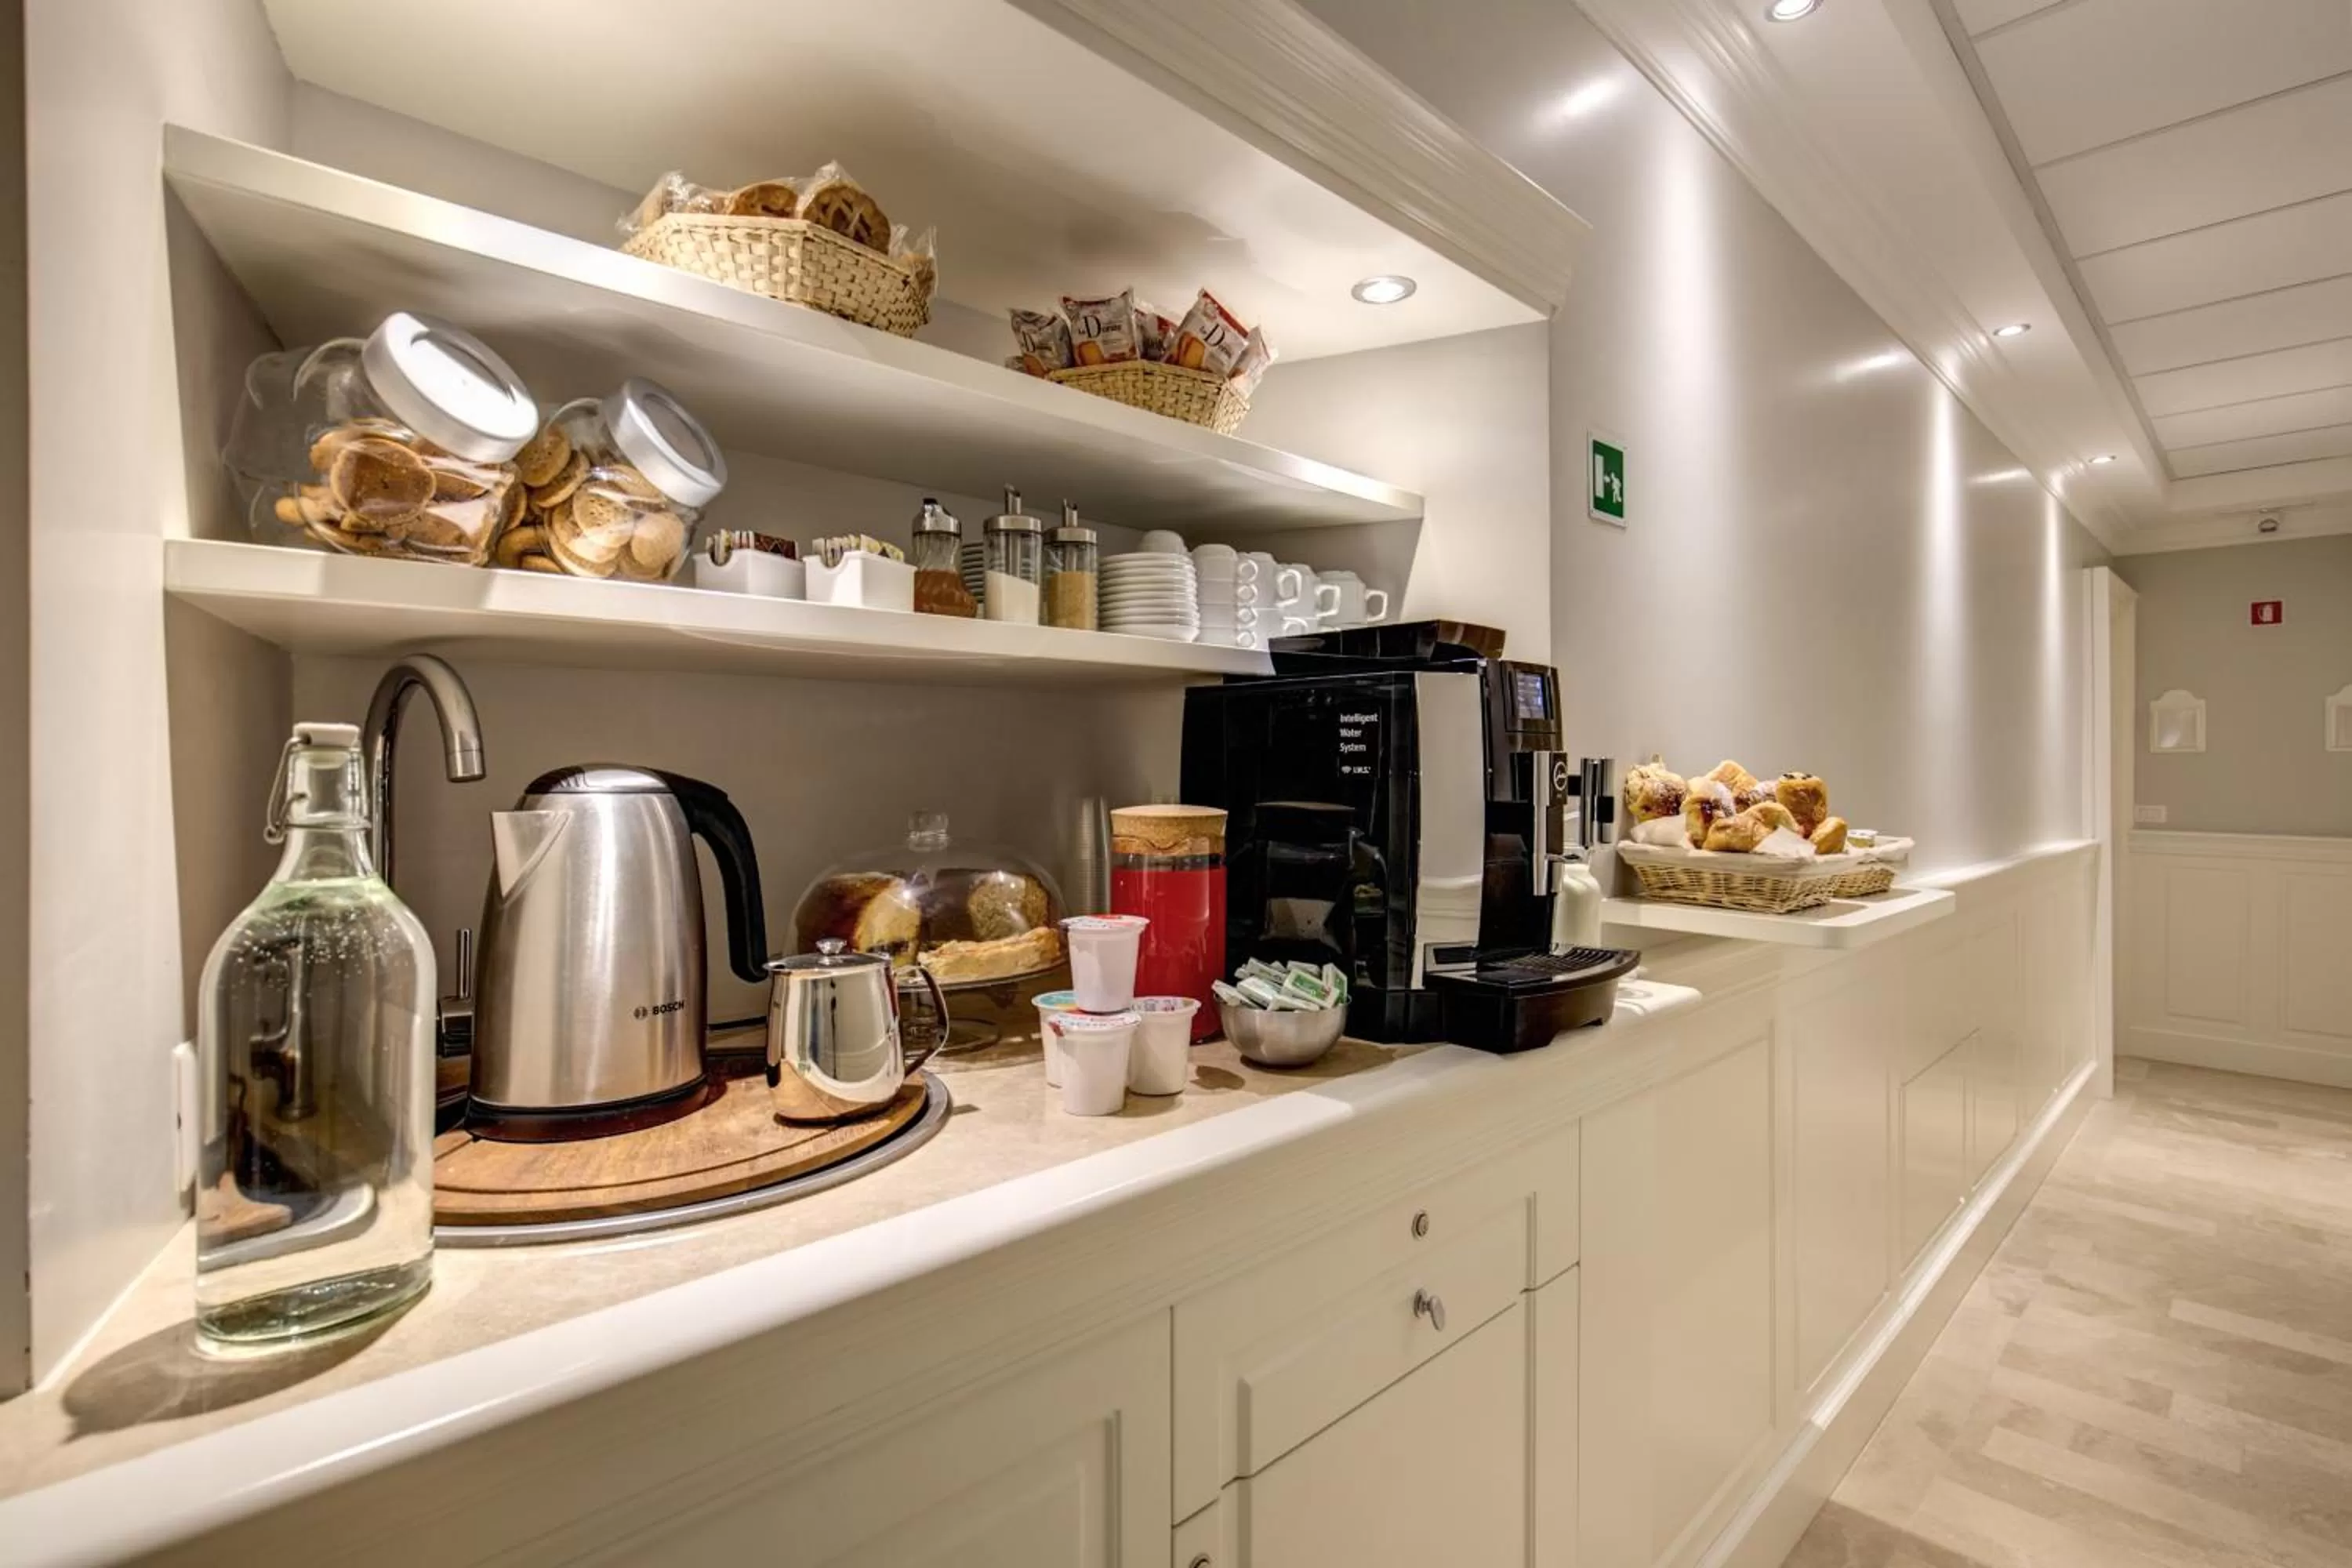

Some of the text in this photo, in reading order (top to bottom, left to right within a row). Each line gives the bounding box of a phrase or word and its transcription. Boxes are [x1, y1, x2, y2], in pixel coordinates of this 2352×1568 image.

[1340, 713, 1378, 724] Intelligent
[1340, 728, 1363, 738] Water
[1339, 742, 1367, 753] System
[652, 1000, 684, 1015] BOSCH
